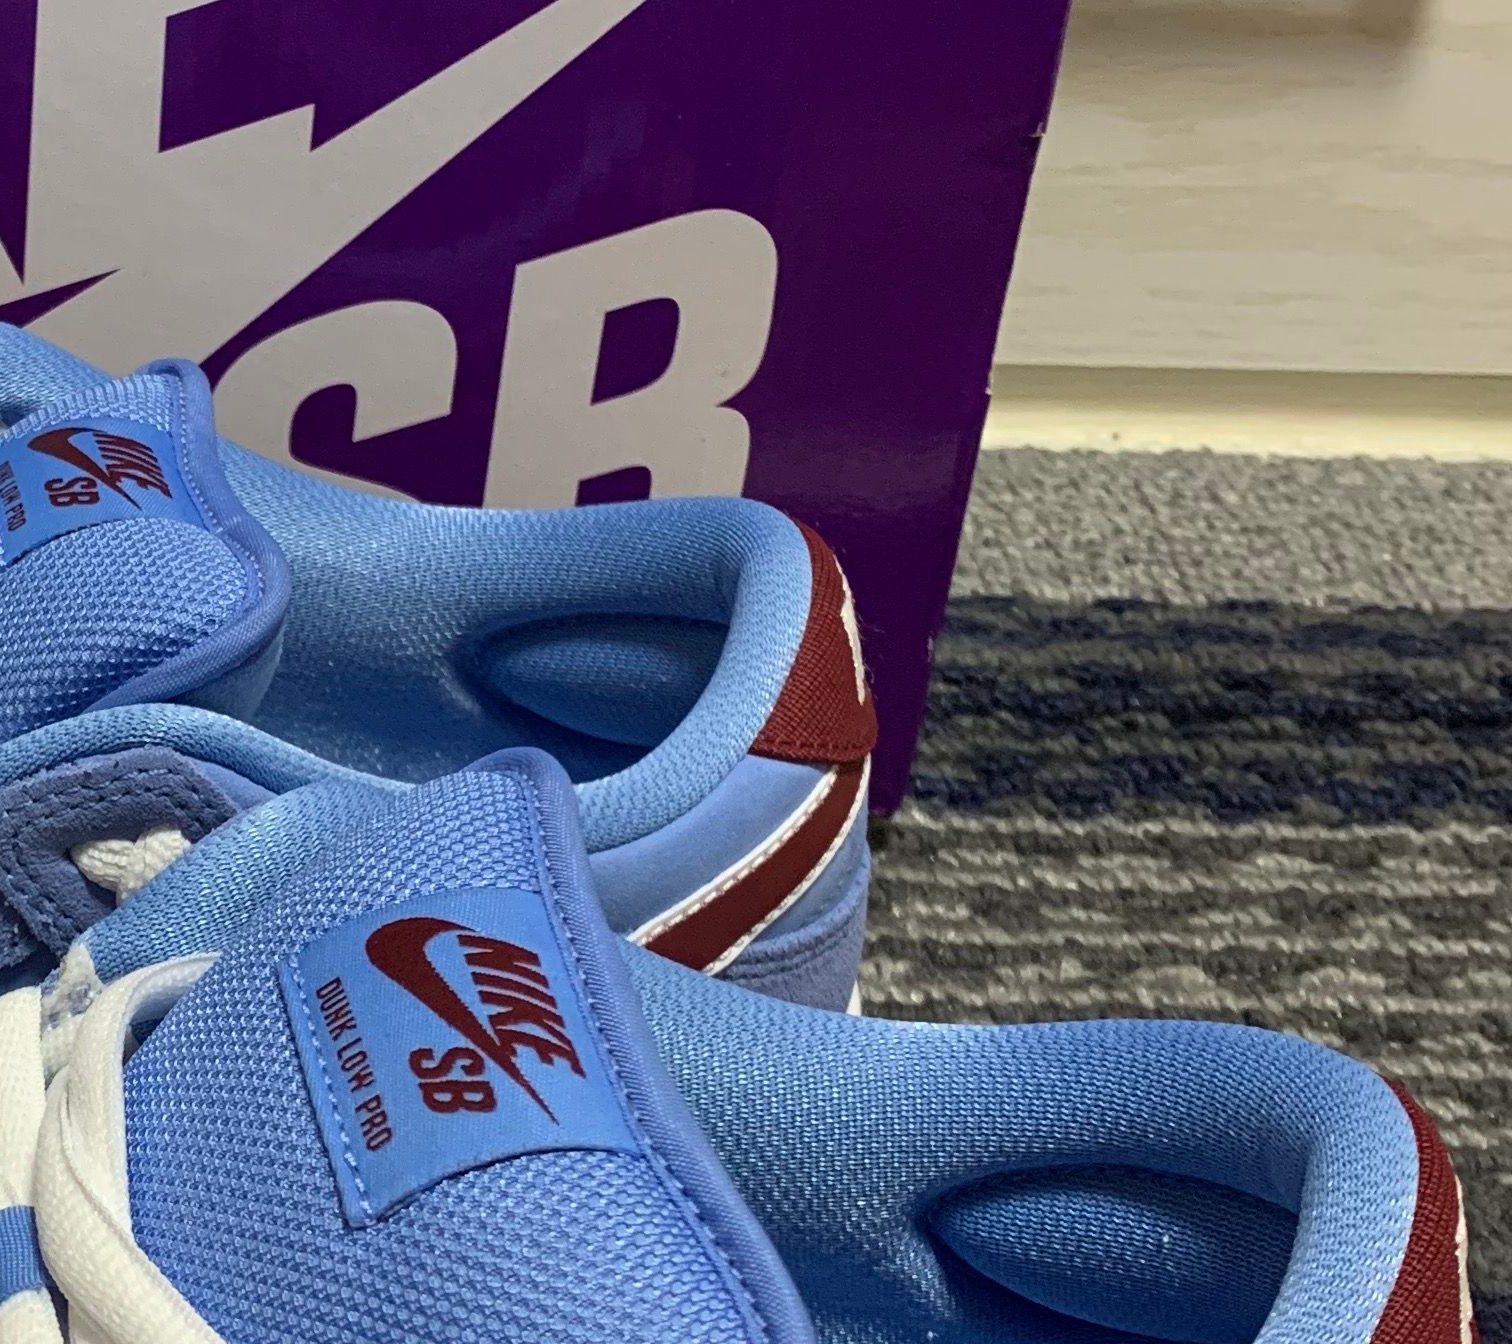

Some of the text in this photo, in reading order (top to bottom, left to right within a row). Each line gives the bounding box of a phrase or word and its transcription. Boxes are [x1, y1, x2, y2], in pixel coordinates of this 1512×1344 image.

[212, 207, 779, 510] SB
[44, 475, 100, 507] SB
[93, 431, 173, 499] NIKE
[456, 934, 587, 1079] NIKE
[315, 977, 393, 1152] DUNK LOW PRO
[408, 1047, 497, 1113] SB
